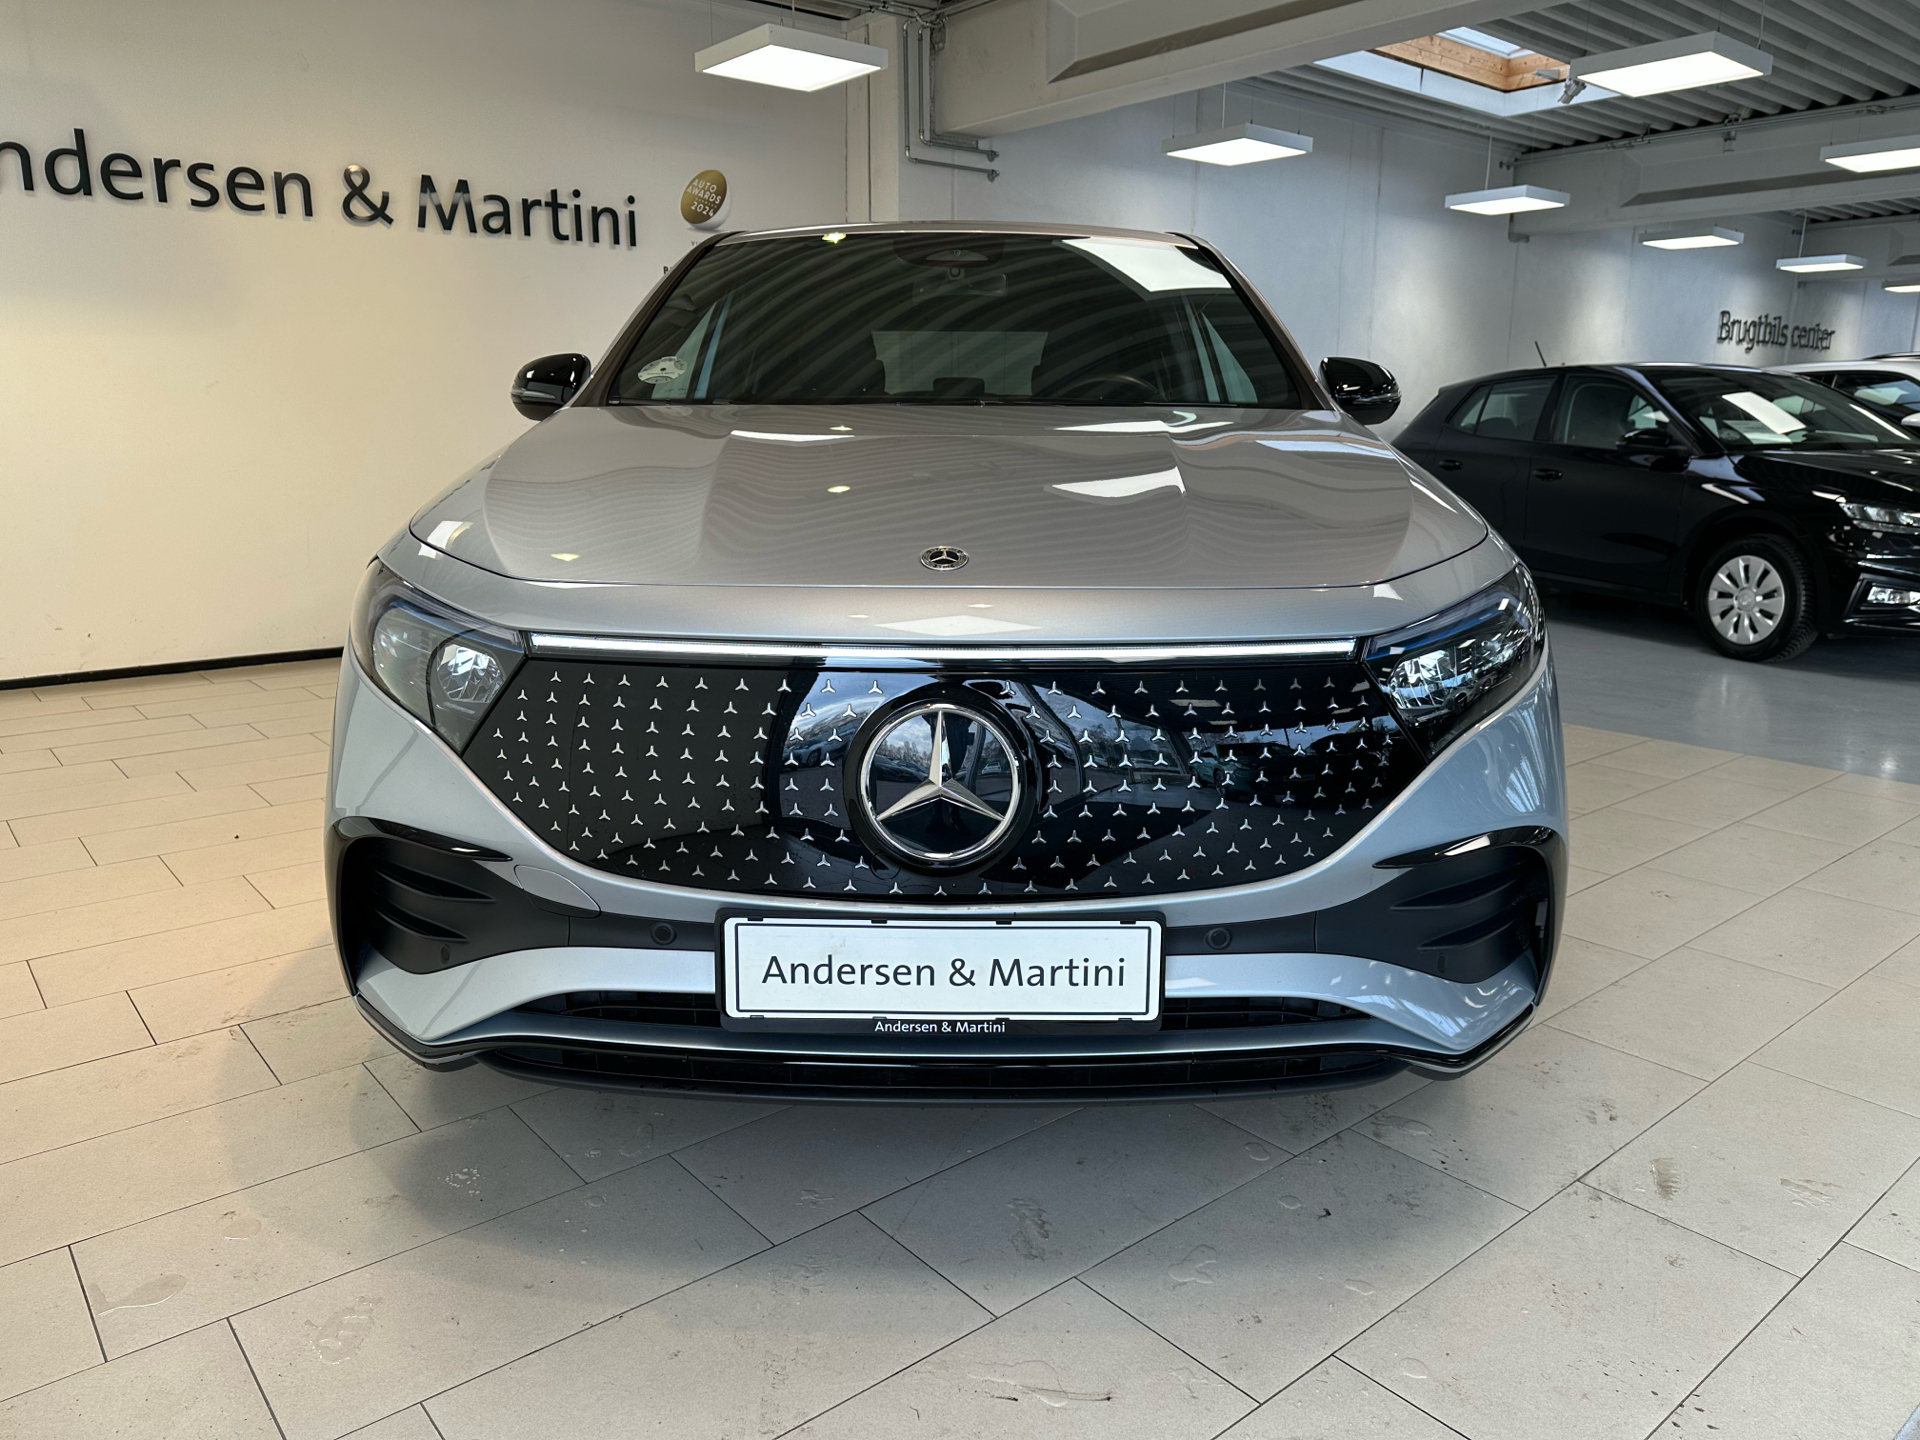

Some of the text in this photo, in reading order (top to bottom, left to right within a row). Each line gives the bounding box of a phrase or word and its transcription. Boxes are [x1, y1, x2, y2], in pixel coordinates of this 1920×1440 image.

[686, 185, 722, 204] AWARDS
[692, 179, 717, 193] AUTO
[342, 164, 394, 225] &
[417, 174, 637, 247] Martini
[691, 201, 715, 217] 2024
[1717, 310, 1835, 352] Brugtbils center
[761, 954, 1125, 987] Andersen & Martini
[874, 1020, 1006, 1033] Andersen & Martini
